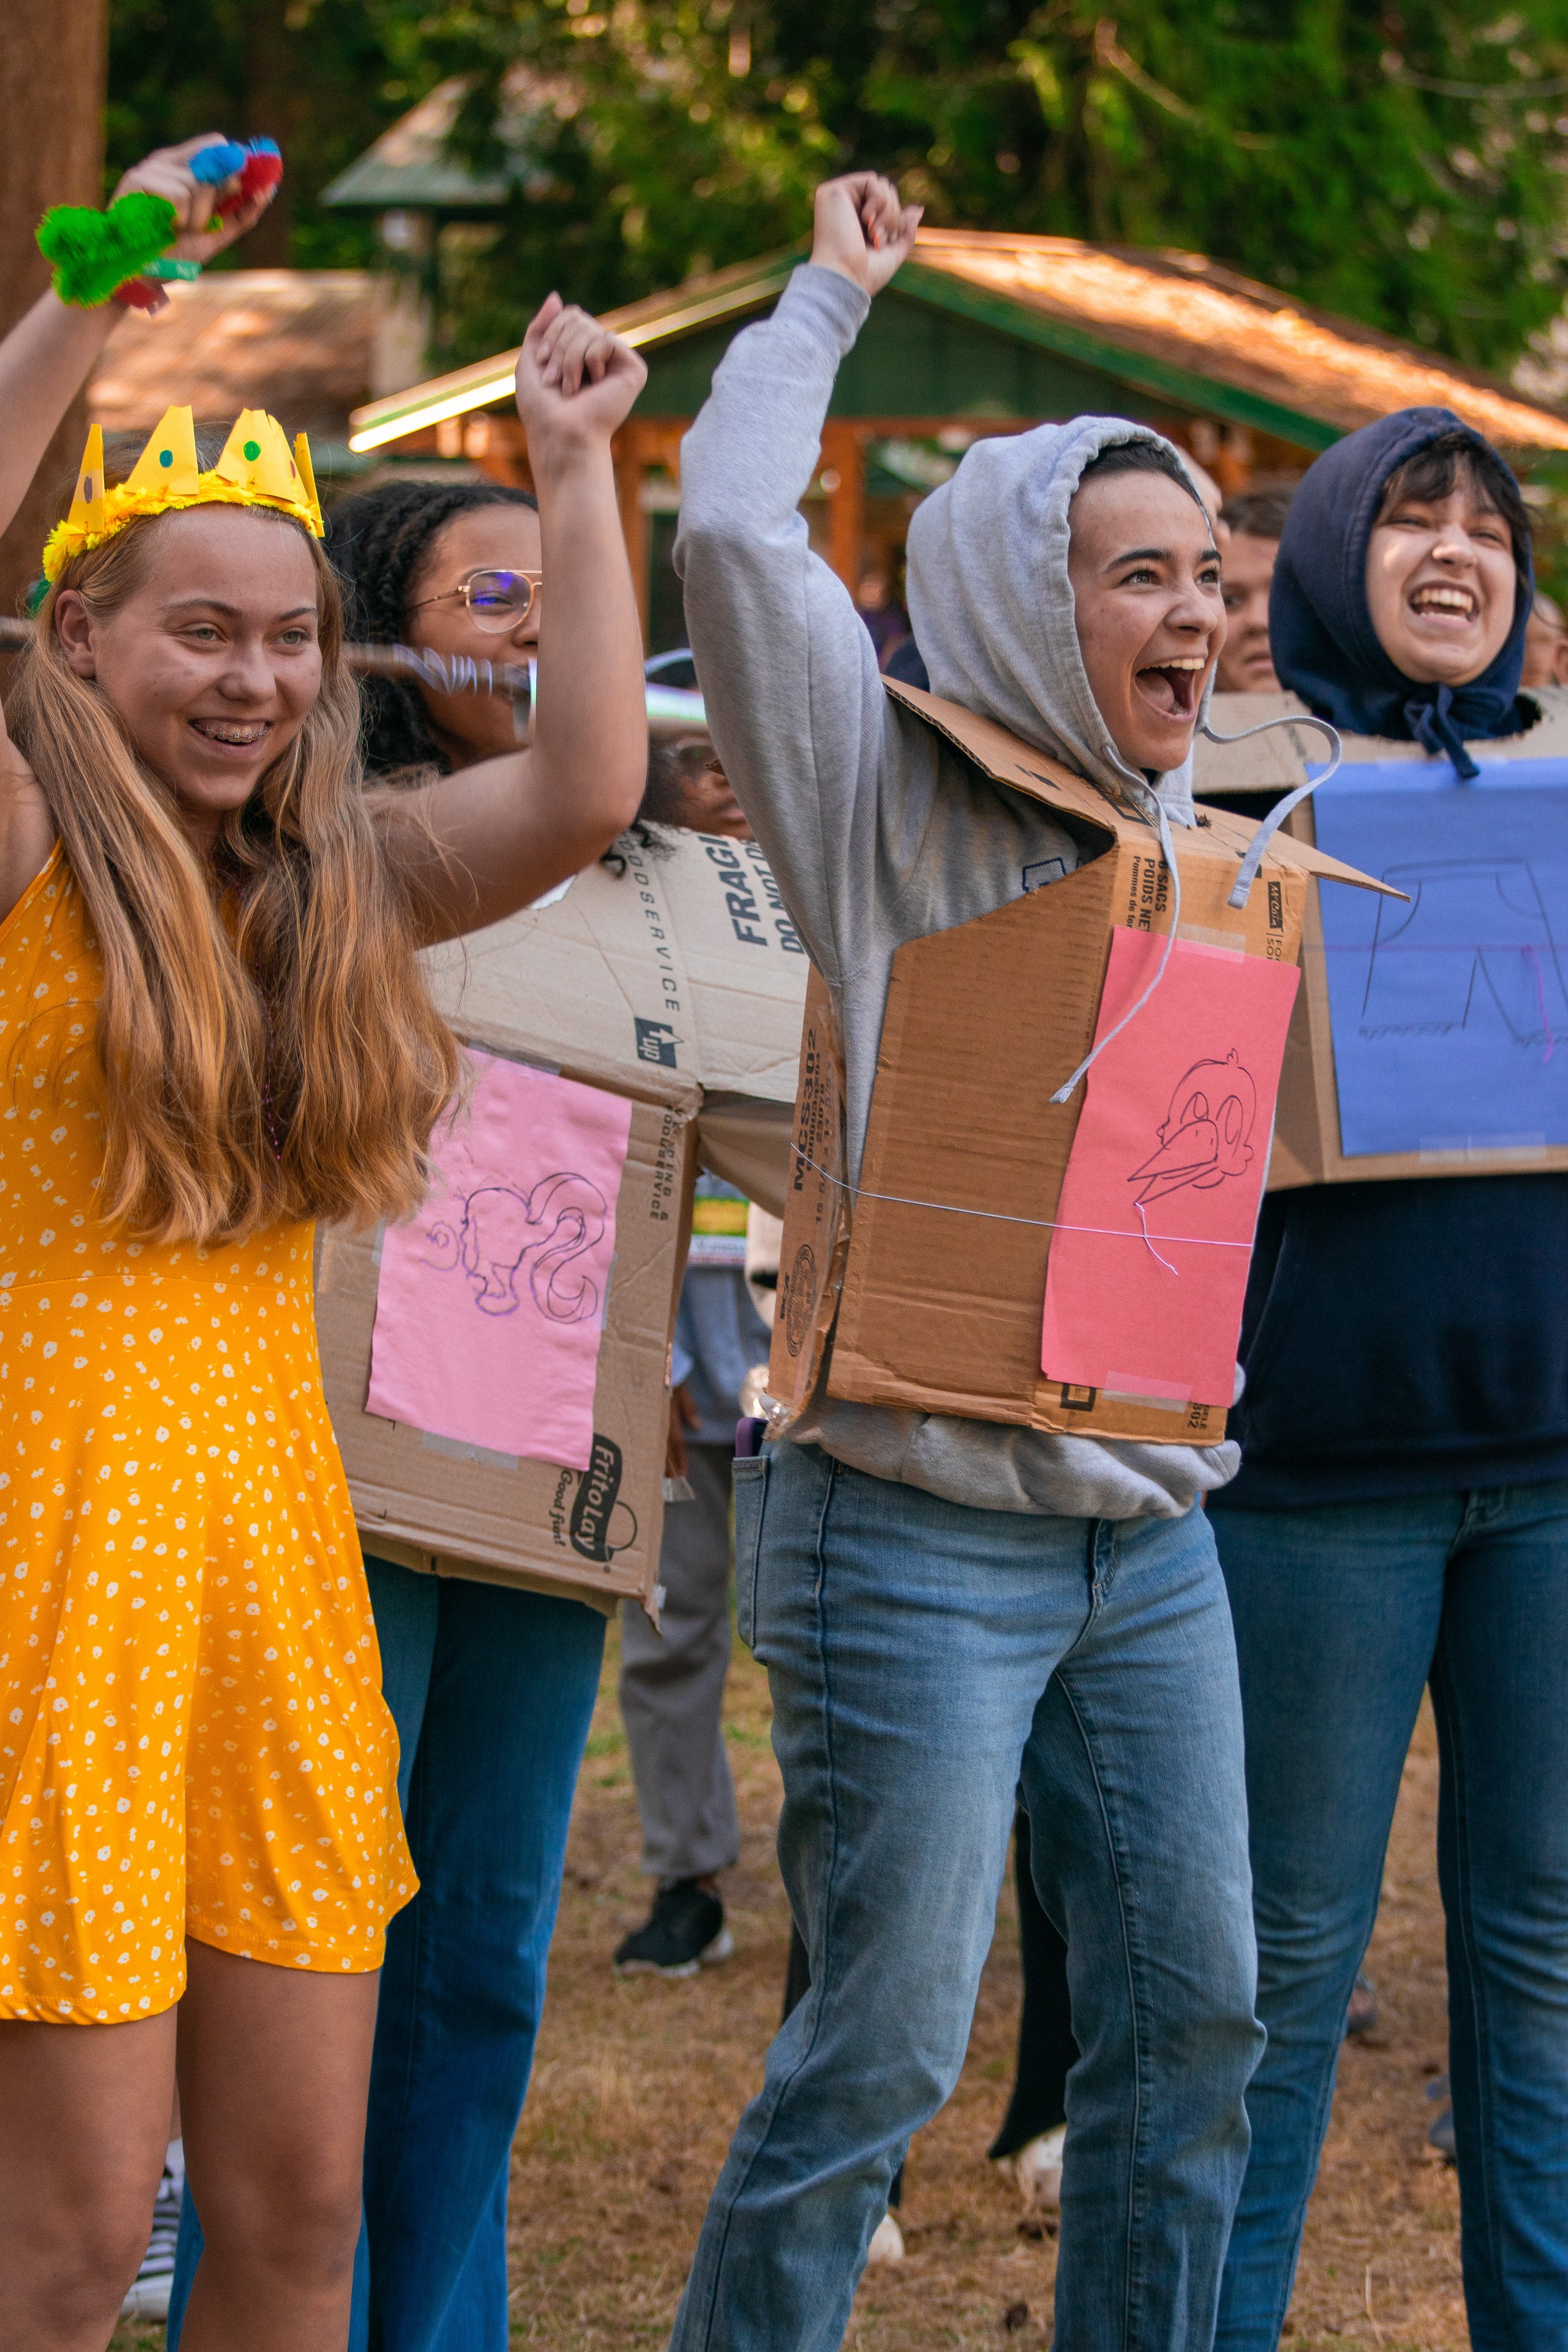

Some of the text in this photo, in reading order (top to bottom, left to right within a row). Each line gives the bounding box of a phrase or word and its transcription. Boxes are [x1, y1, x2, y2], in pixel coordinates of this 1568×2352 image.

[1130, 856, 1141, 897] Pommes
[1142, 859, 1155, 904] POIDS
[1155, 874, 1168, 913] SACS
[618, 835, 680, 1012] OODSERVICE
[1129, 900, 1137, 912] de
[1269, 882, 1281, 927] McCain
[775, 919, 805, 954] DO
[638, 1036, 660, 1060] up
[793, 1029, 816, 1191] MCS302
[549, 1470, 573, 1547] Good fun!
